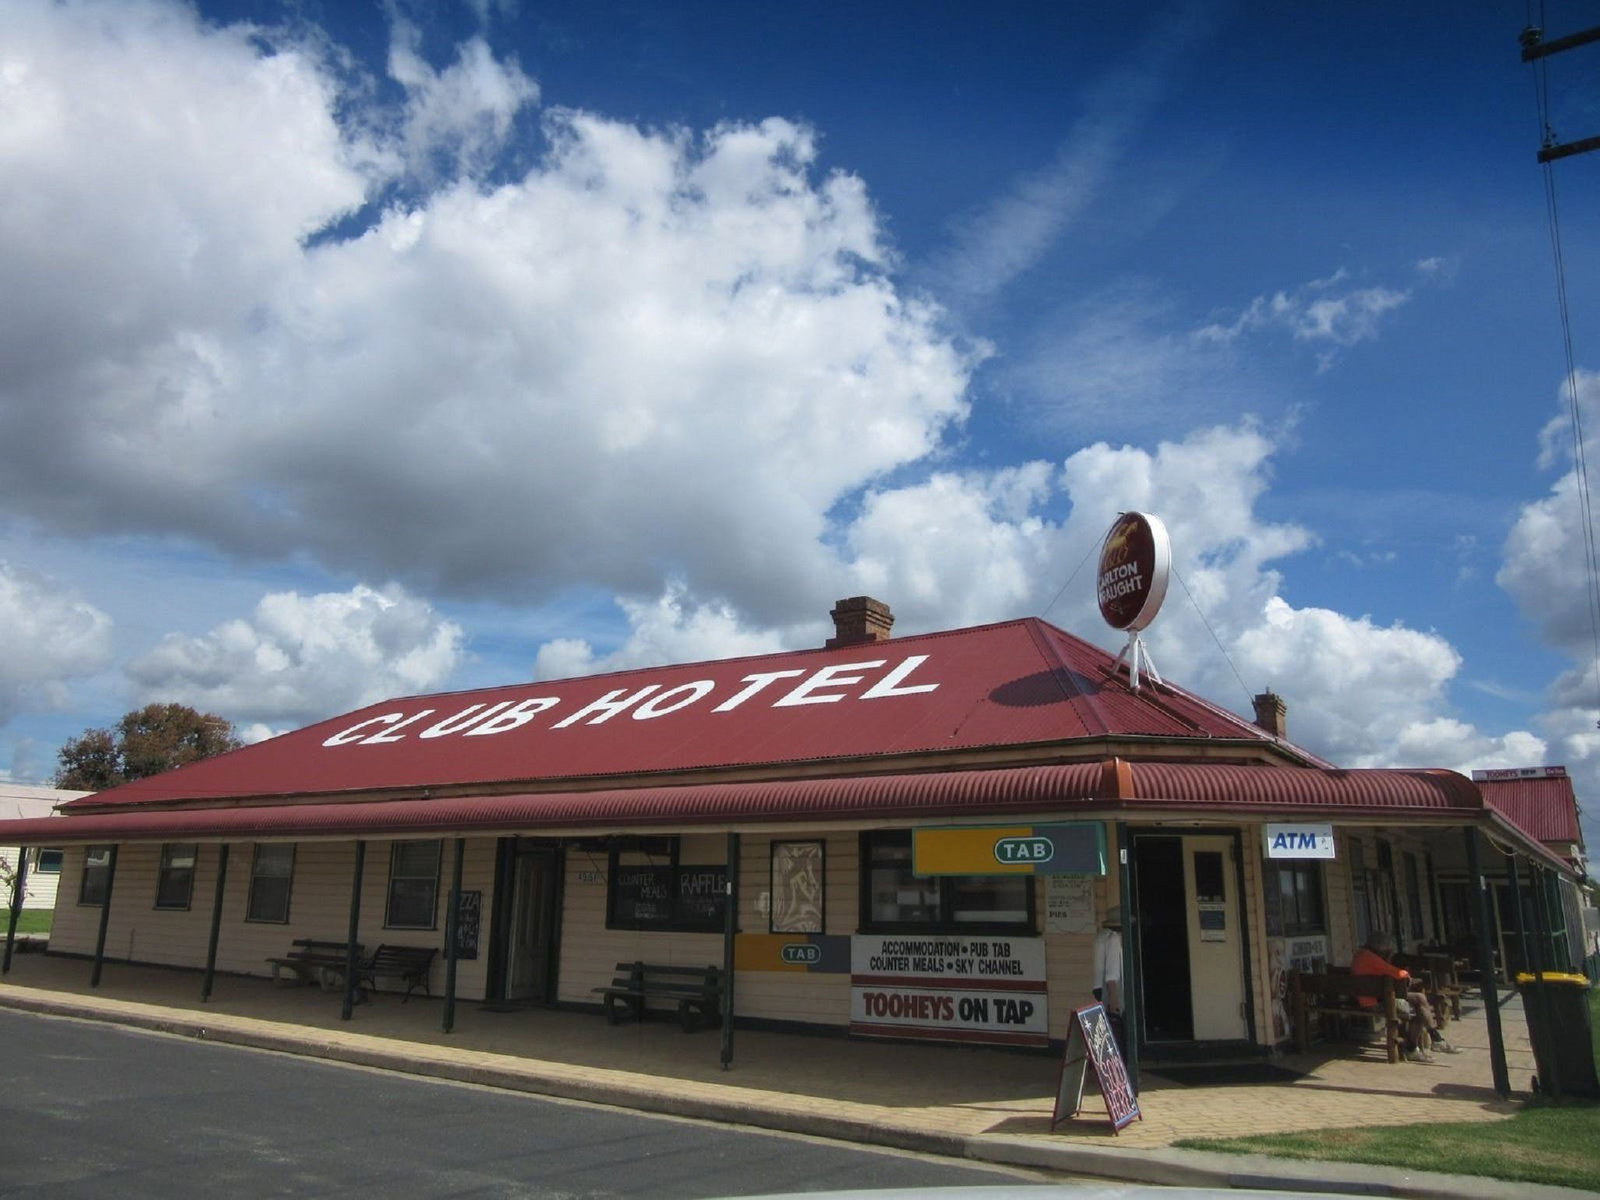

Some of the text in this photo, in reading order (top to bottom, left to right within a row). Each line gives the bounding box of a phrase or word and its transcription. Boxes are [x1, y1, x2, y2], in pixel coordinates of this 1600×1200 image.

[322, 655, 940, 746] CLUB HOTEL
[1273, 832, 1317, 850] ATM
[1003, 843, 1046, 858] TAB
[680, 873, 726, 897] RAFFLE
[788, 948, 816, 961] TAB
[881, 941, 1011, 958] ACCOMMODATION PUB TAB
[870, 957, 1024, 975] COUNTER MEALS SKY CHANNEL
[863, 992, 1034, 1025] TOOHEYS ON TAP
